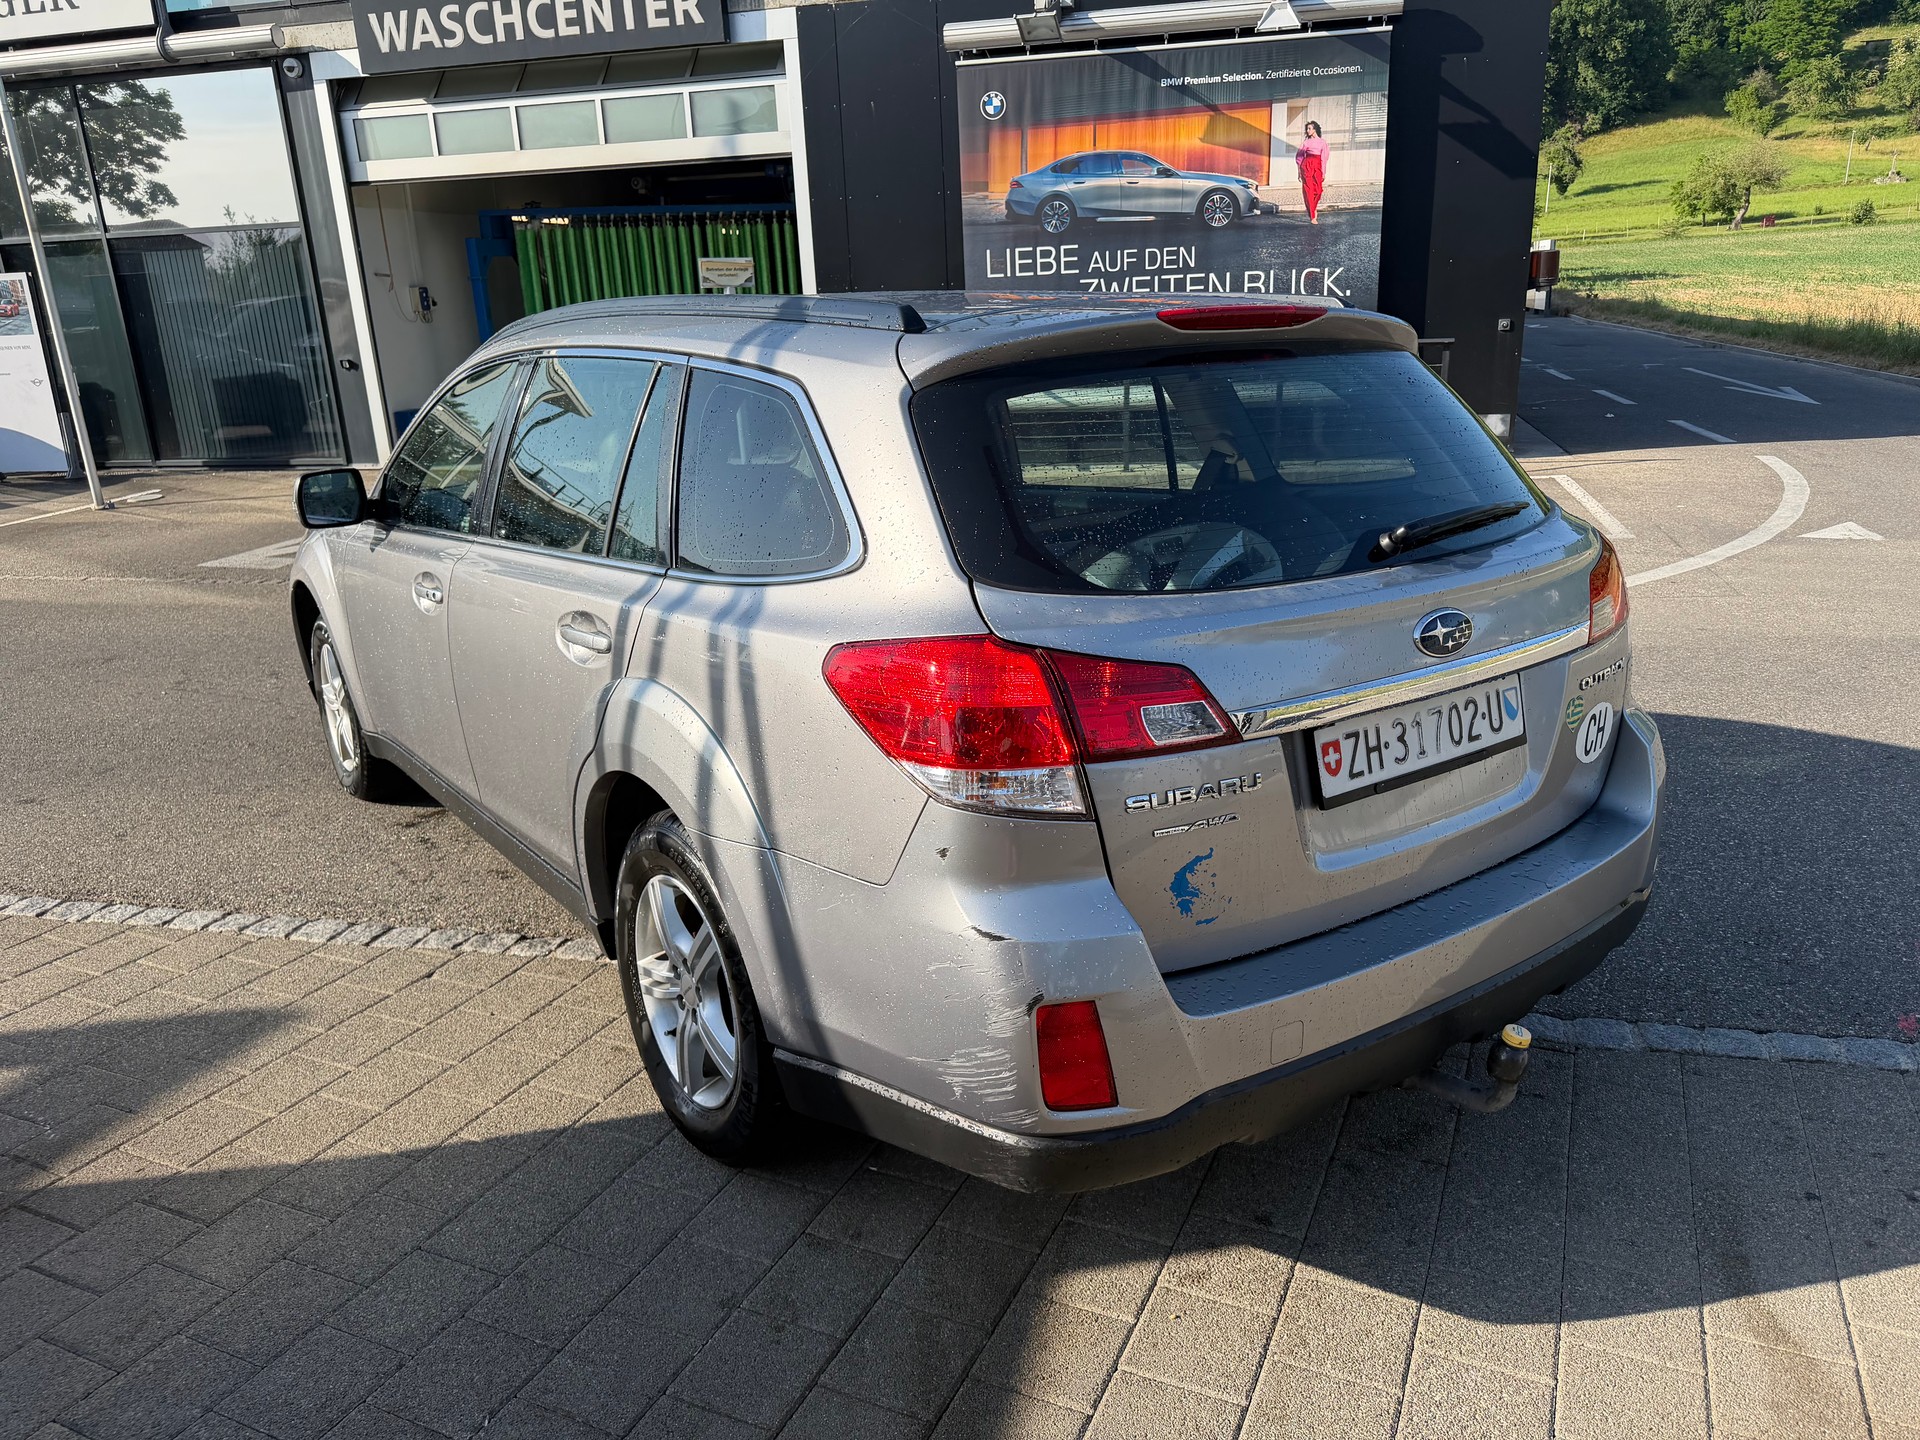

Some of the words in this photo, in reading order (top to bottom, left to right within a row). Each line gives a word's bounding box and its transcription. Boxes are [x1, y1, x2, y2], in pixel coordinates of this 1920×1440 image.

[368, 0, 705, 53] WASCHCENTER
[1161, 77, 1184, 87] BMW
[1184, 75, 1221, 85] Premium
[1222, 72, 1264, 82] Selection.
[1266, 69, 1311, 79] Zertifizierte
[1312, 65, 1363, 76] Occasionen.
[986, 244, 1079, 278] LIEBE
[1088, 249, 1138, 273] AUF
[1145, 246, 1196, 270] DEN
[1584, 706, 1608, 757] CH
[1125, 772, 1262, 814] SUBARU
